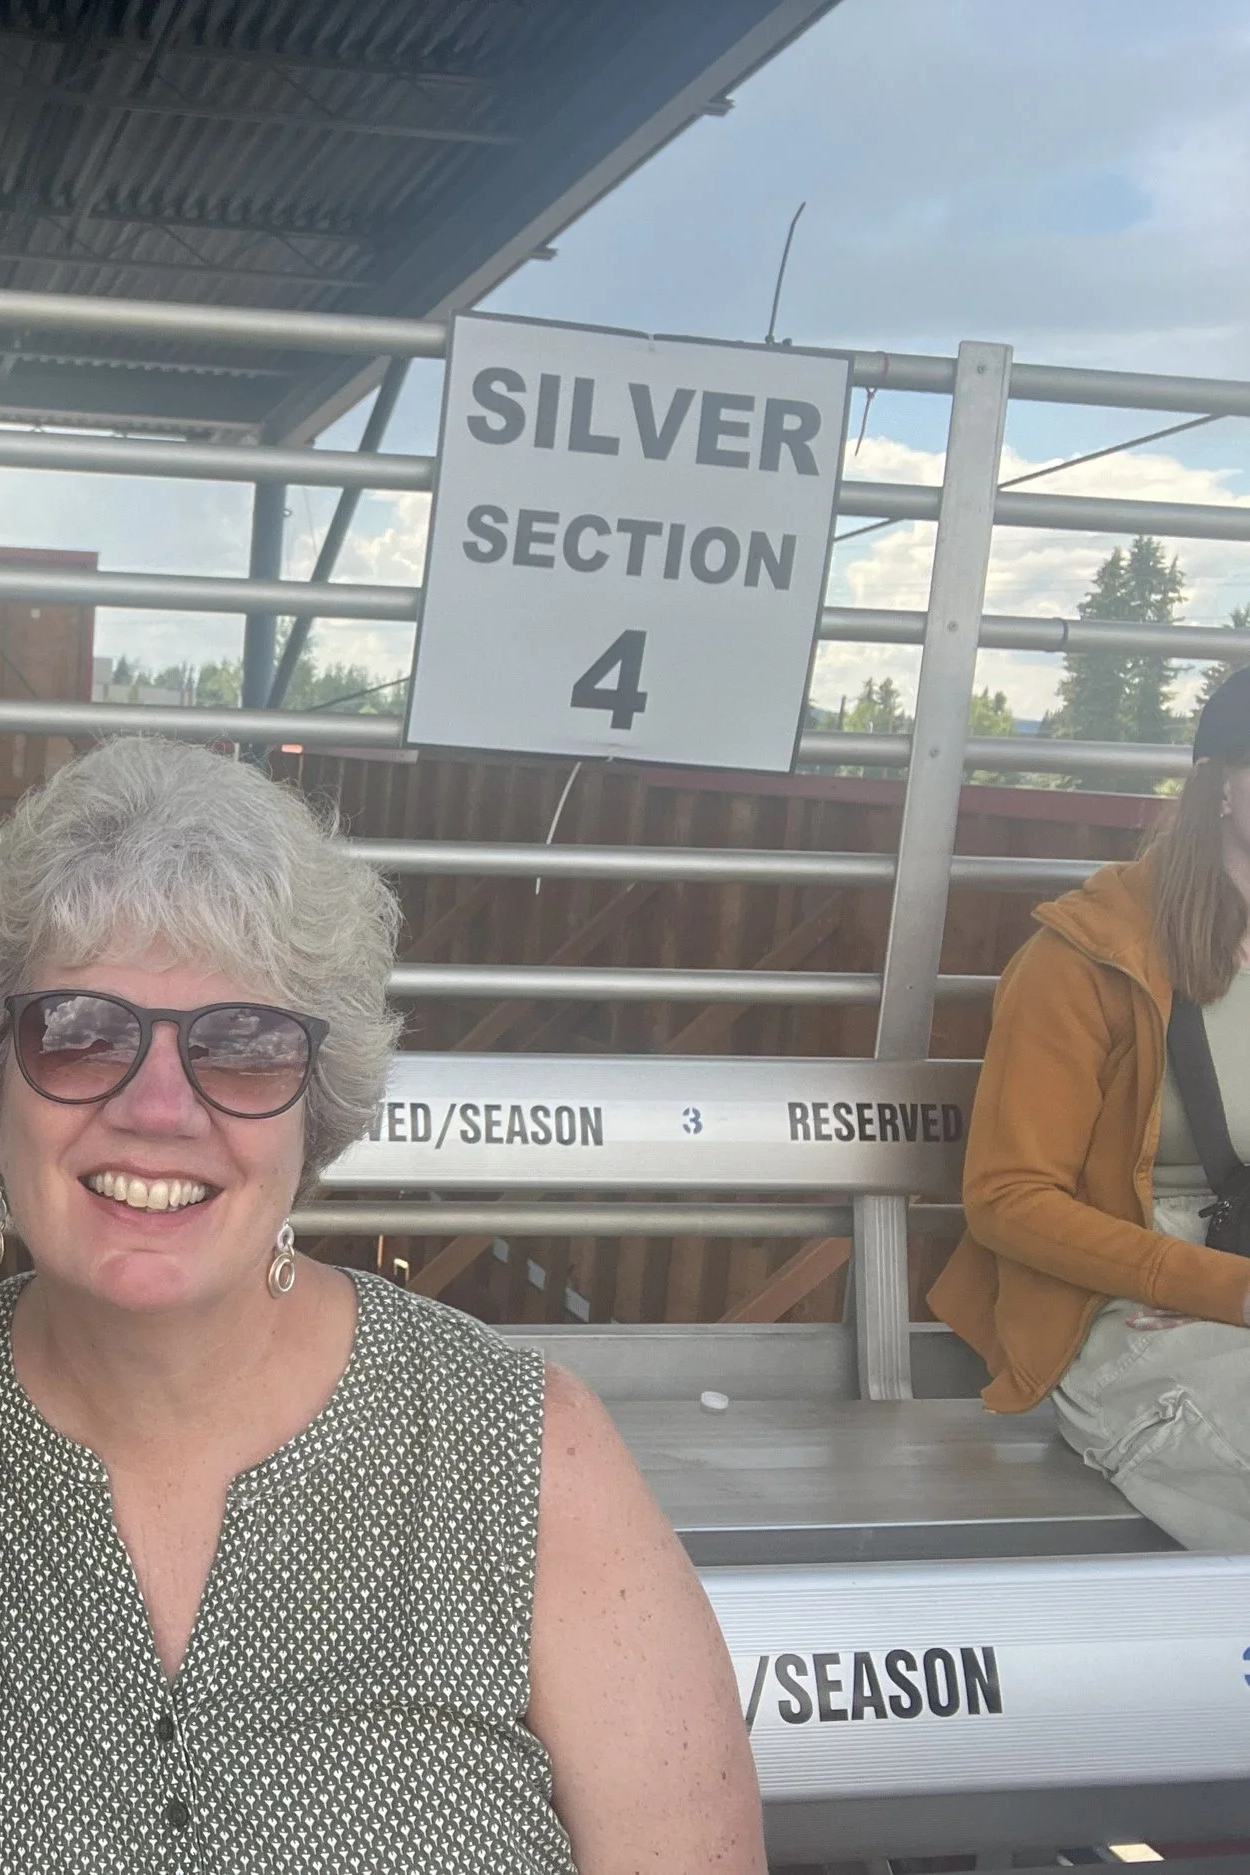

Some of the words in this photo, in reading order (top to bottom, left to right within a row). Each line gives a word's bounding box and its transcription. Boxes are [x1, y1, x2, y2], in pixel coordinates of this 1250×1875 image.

[466, 366, 822, 476] SILVER
[462, 504, 797, 591] SECTION
[569, 628, 648, 731] 4
[681, 1106, 704, 1135] 3
[787, 1101, 964, 1143] RESERVED
